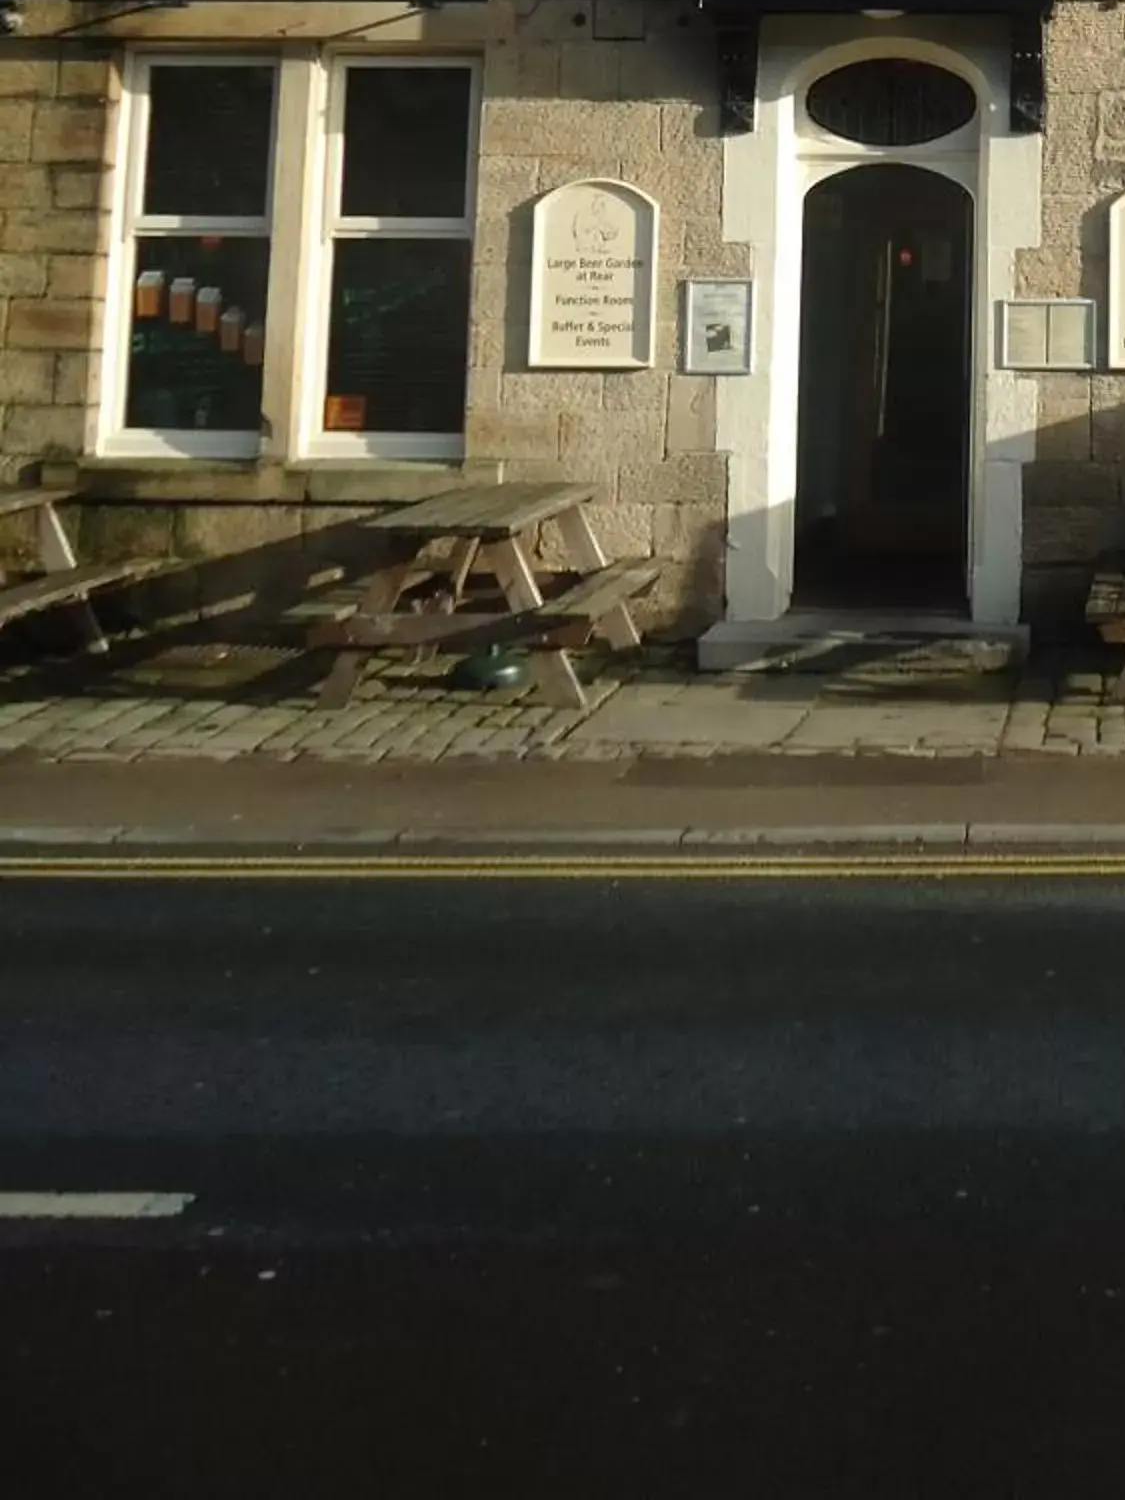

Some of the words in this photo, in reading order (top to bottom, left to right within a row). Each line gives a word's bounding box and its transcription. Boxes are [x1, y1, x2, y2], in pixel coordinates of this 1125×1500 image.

[547, 258, 576, 271] Large
[579, 258, 602, 269] Beer
[576, 271, 587, 281] at
[589, 271, 614, 281] Rear
[555, 295, 599, 306] Function
[603, 295, 635, 305] Room
[551, 321, 583, 333] Buffet
[586, 321, 595, 332] &
[598, 321, 635, 334] Special
[575, 335, 611, 347] Events
